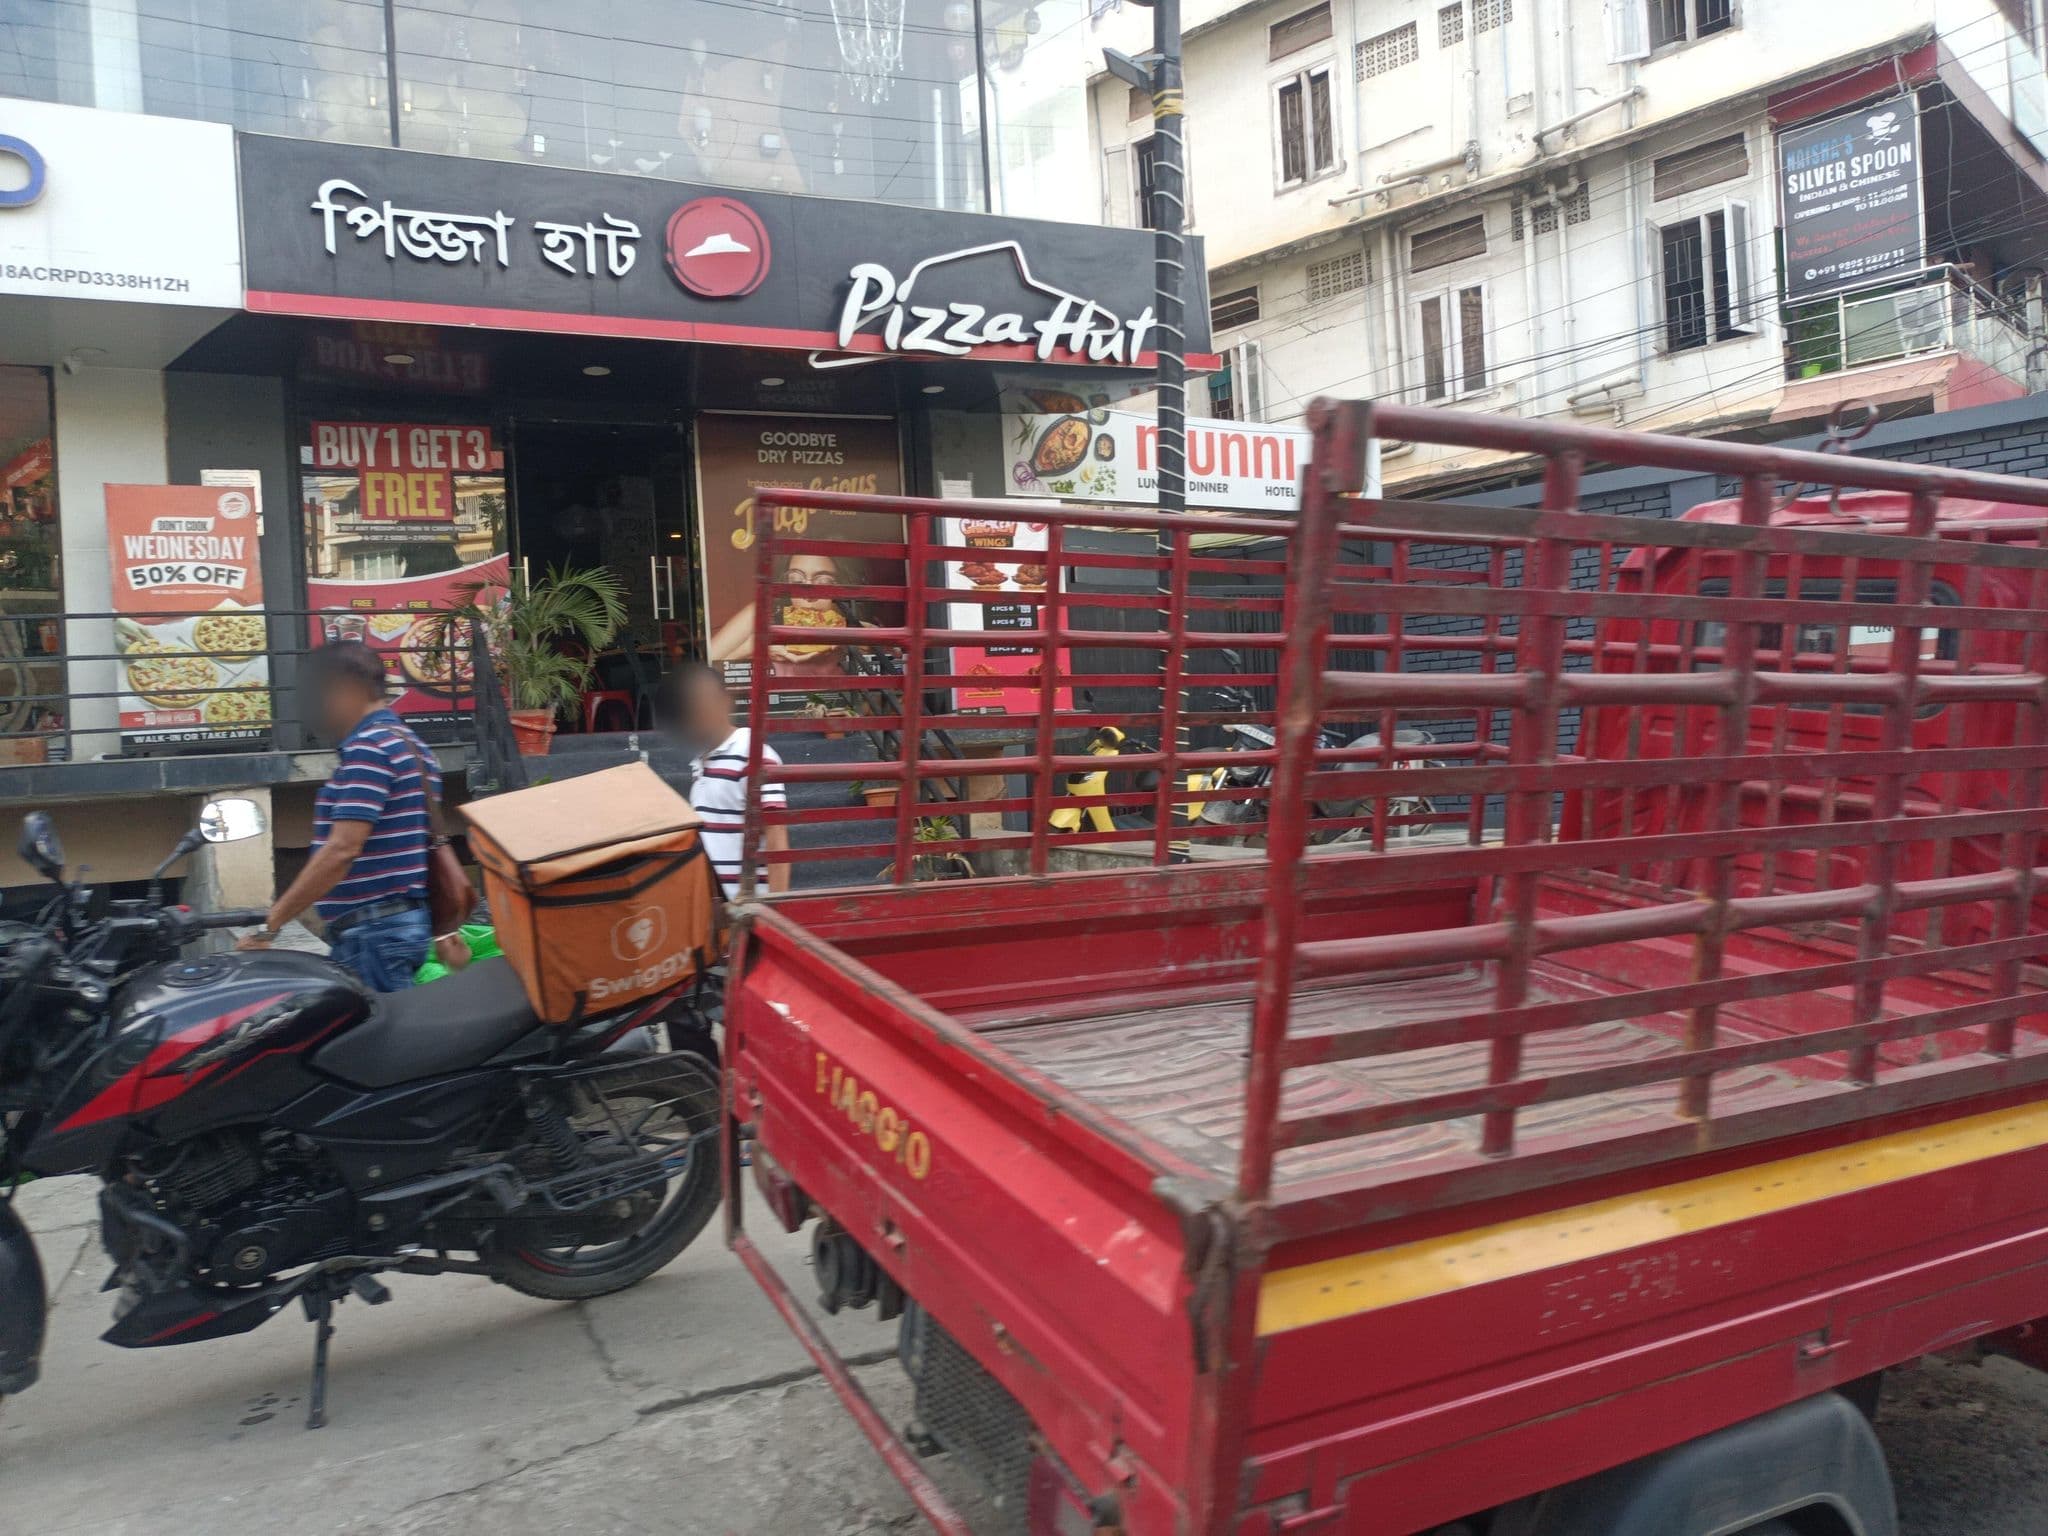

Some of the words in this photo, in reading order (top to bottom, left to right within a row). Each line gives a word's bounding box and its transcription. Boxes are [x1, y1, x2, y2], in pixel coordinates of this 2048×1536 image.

[1787, 161, 1847, 195] SILVER
[1850, 142, 1912, 177] SPOON
[1838, 181, 1848, 192] &
[1849, 169, 1901, 189] CHINESE
[1855, 203, 1867, 212] TO
[310, 179, 515, 267] পিজ্জা
[534, 213, 642, 277] হাট
[838, 263, 1029, 356] Pizza
[1032, 296, 1158, 364] Hut
[318, 425, 379, 467] BUY
[384, 428, 400, 468] 1
[409, 428, 465, 469] GET
[466, 430, 486, 470] 3
[760, 431, 837, 448] GOODBYE
[757, 450, 788, 464] DRY
[792, 451, 844, 465] PIZZAS
[365, 471, 446, 518] FREE
[1188, 481, 1229, 495] DINNER
[1265, 485, 1296, 498] HOTEL
[123, 535, 246, 560] WEDNESDAY
[974, 537, 1007, 547] WINGS
[131, 565, 187, 586] 50%
[193, 565, 242, 586] OFF
[133, 734, 182, 744] WALK-IN
[183, 732, 199, 742] OR
[201, 731, 226, 741] TAKE
[228, 729, 261, 740] AWAY
[589, 946, 693, 999] Swiggy
